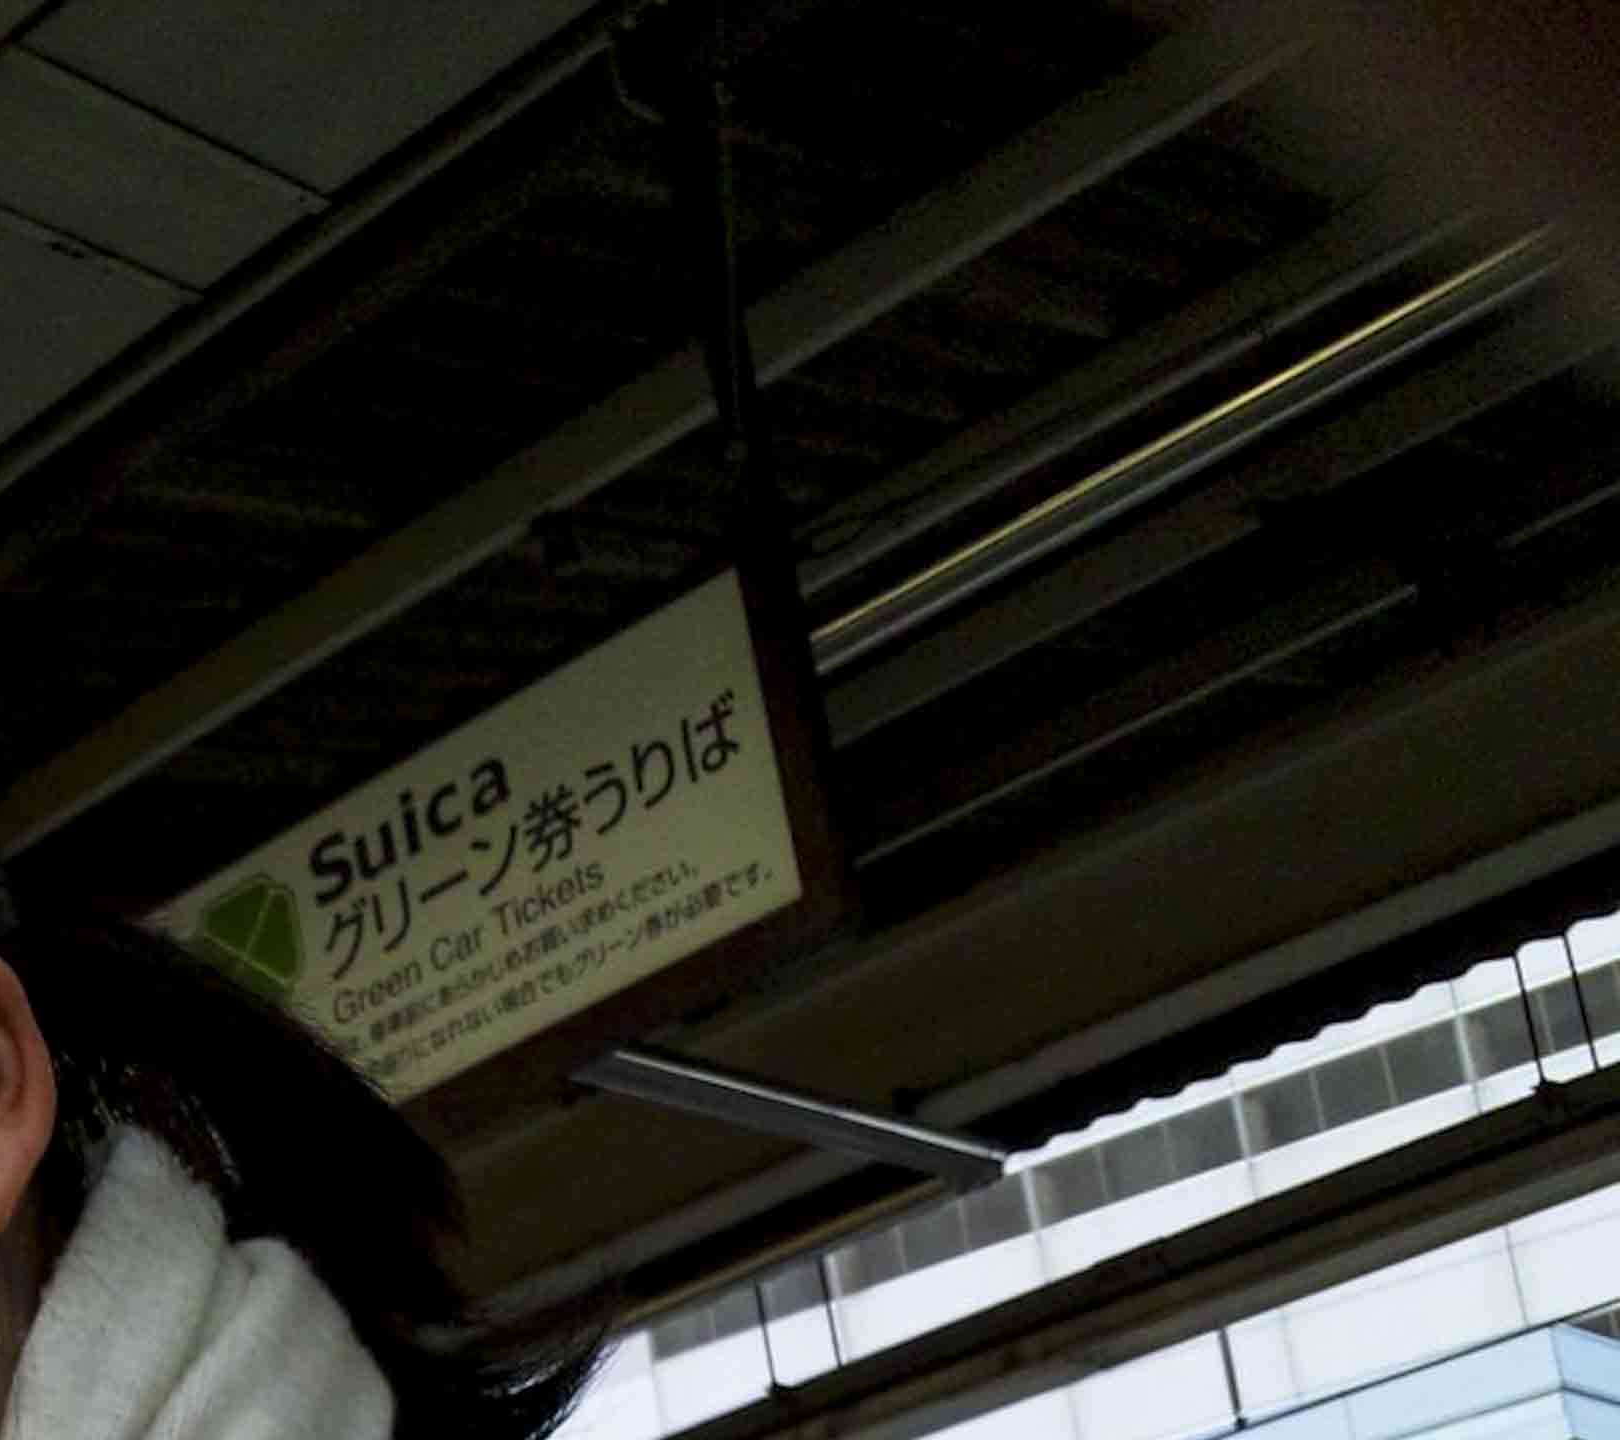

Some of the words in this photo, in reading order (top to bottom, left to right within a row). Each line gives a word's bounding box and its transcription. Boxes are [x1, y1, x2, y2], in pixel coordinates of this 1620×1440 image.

[309, 754, 512, 906] Suica
[325, 688, 741, 981] グリーン券うりば
[332, 960, 424, 1025] Green
[430, 923, 485, 973] Car
[492, 861, 606, 938] Tickets
